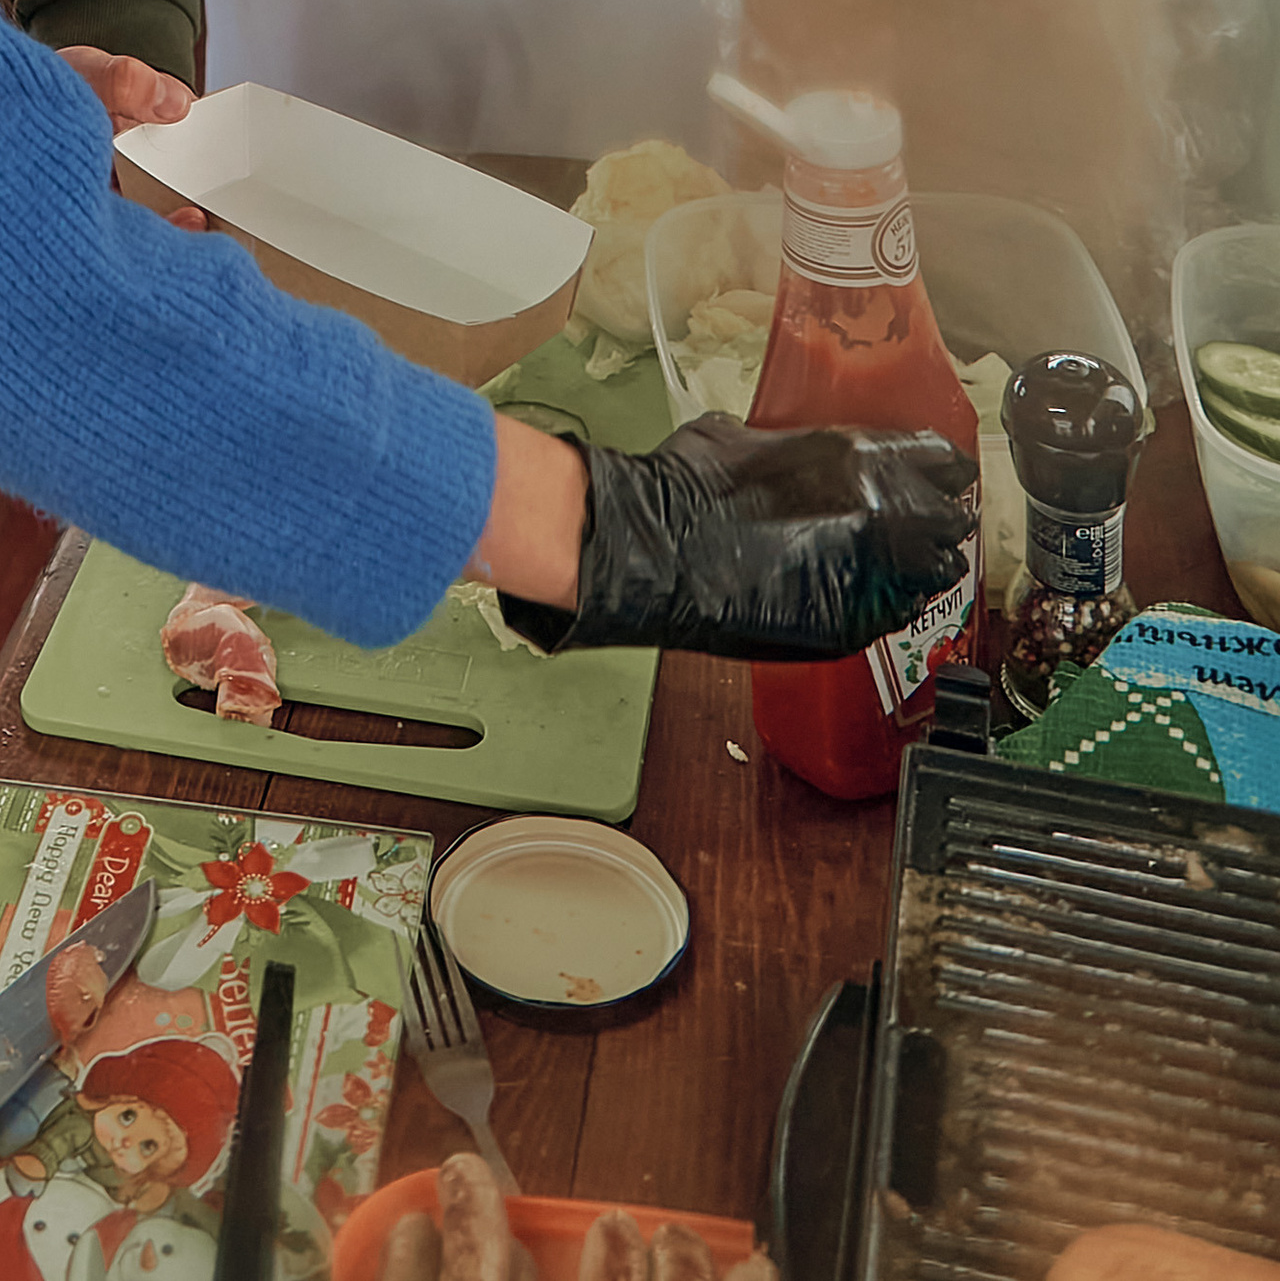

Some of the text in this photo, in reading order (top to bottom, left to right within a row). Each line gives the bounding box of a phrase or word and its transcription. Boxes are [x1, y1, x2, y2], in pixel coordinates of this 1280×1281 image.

[910, 586, 962, 637] КЕТЧУП
[5, 824, 78, 987] Happy New Ye
[90, 856, 130, 911] Dear
